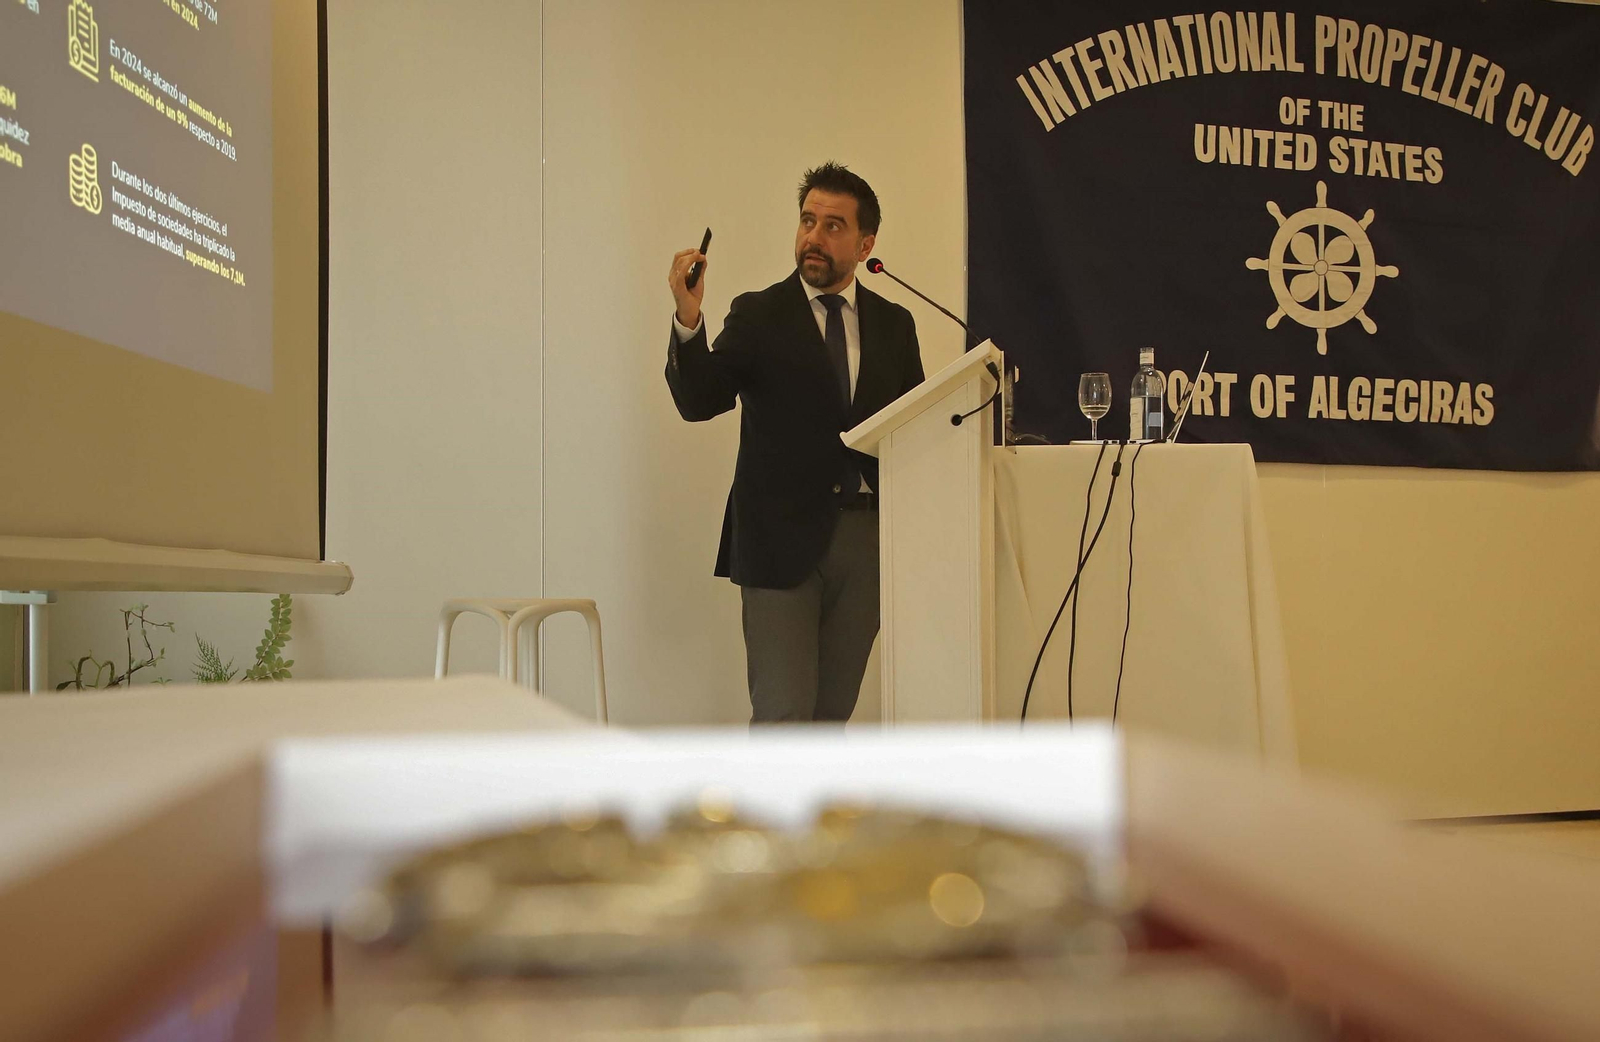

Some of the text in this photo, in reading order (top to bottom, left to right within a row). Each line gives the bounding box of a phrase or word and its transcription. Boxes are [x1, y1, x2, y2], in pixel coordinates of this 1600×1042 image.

[170, 0, 200, 31] en 2024.
[203, 1, 218, 25] 72M
[109, 38, 233, 138] En 2024 se alcanzó un aumento de la
[109, 64, 238, 162] facturación de un 9% respecto a 2019.
[1016, 11, 1596, 178] INTERNATIONAL PROPELLER CLUB
[1279, 96, 1365, 132] OF THE
[1194, 123, 1444, 185] UNITED STATES
[111, 160, 228, 237] Durante los dos últimos ejercicios, el
[112, 185, 236, 262] Impuesto de sociedades ha triplicado la
[112, 213, 136, 236] media
[136, 225, 156, 245] anual
[156, 230, 185, 260] habitual,
[185, 248, 220, 275] superando
[220, 261, 231, 279] los
[1249, 373, 1298, 418] OF
[1308, 374, 1495, 426] ALGECIRAS
